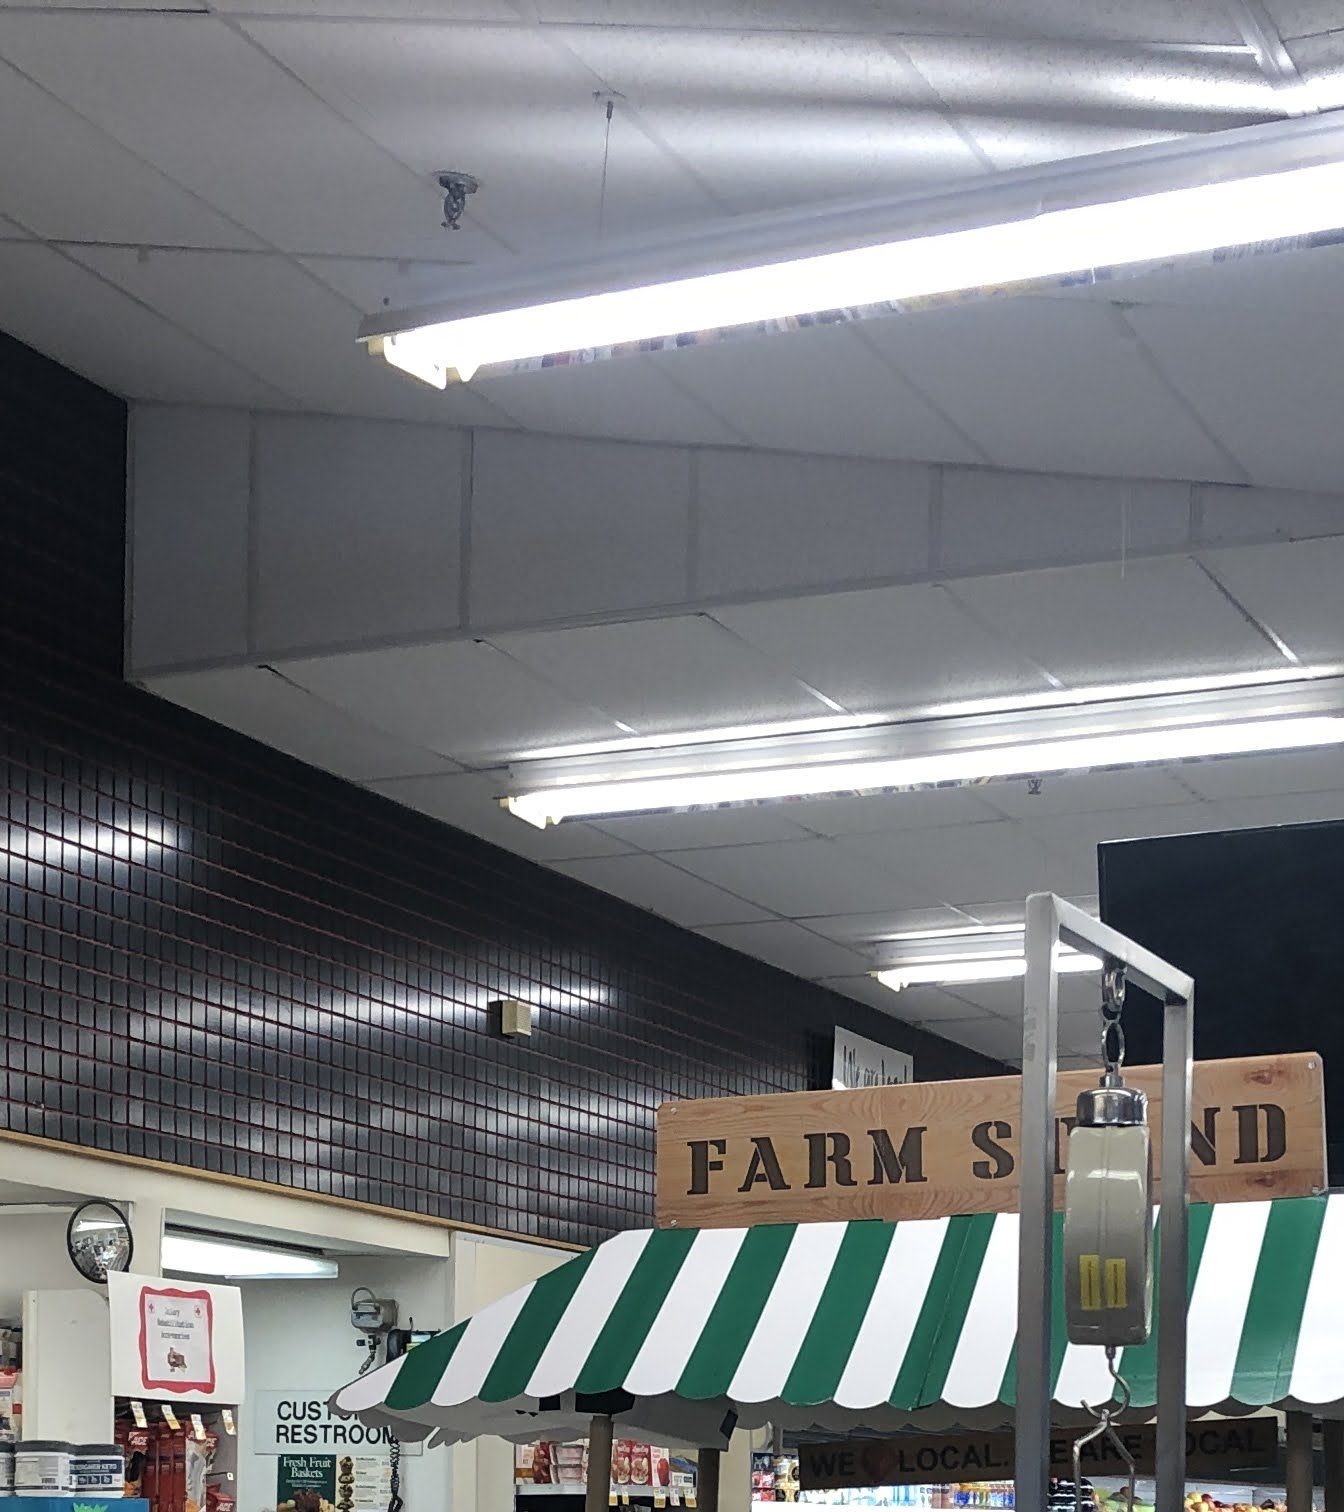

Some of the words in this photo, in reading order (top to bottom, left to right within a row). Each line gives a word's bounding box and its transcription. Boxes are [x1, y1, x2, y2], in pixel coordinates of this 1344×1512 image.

[686, 1127, 928, 1195] FARM
[970, 1103, 1287, 1180] SND
[131, 1436, 147, 1446] ACE
[283, 1457, 306, 1469] Fresh
[309, 1457, 333, 1469] Fruit
[810, 1452, 855, 1478] WE
[290, 1468, 324, 1480] Baskets
